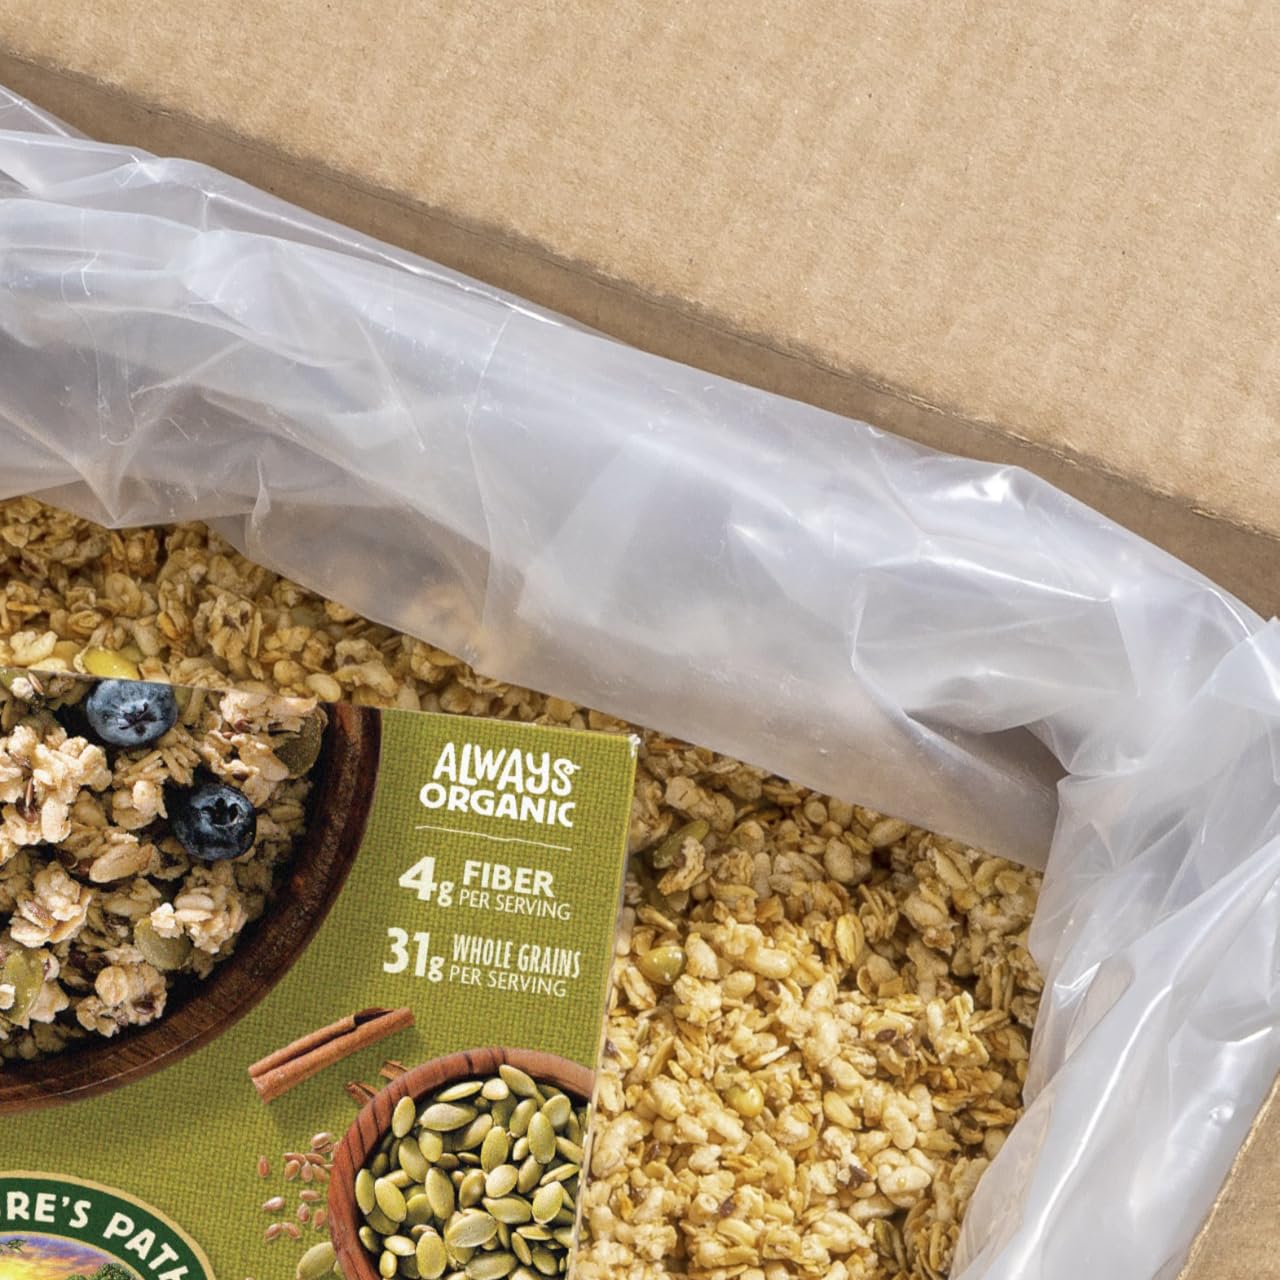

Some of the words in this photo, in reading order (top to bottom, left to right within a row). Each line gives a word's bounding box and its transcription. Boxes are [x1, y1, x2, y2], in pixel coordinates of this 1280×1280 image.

[432, 742, 582, 796] ALWAYS
[420, 782, 576, 828] ORGANIC
[398, 856, 455, 907] 4g
[463, 860, 555, 897] FIBER
[459, 889, 489, 909] PER
[495, 895, 571, 920] SERVING
[383, 927, 445, 982] 31g
[453, 933, 513, 969] WHOLE
[518, 943, 581, 979] GRAINS
[449, 965, 481, 986] PER
[488, 970, 567, 997] SERVING
